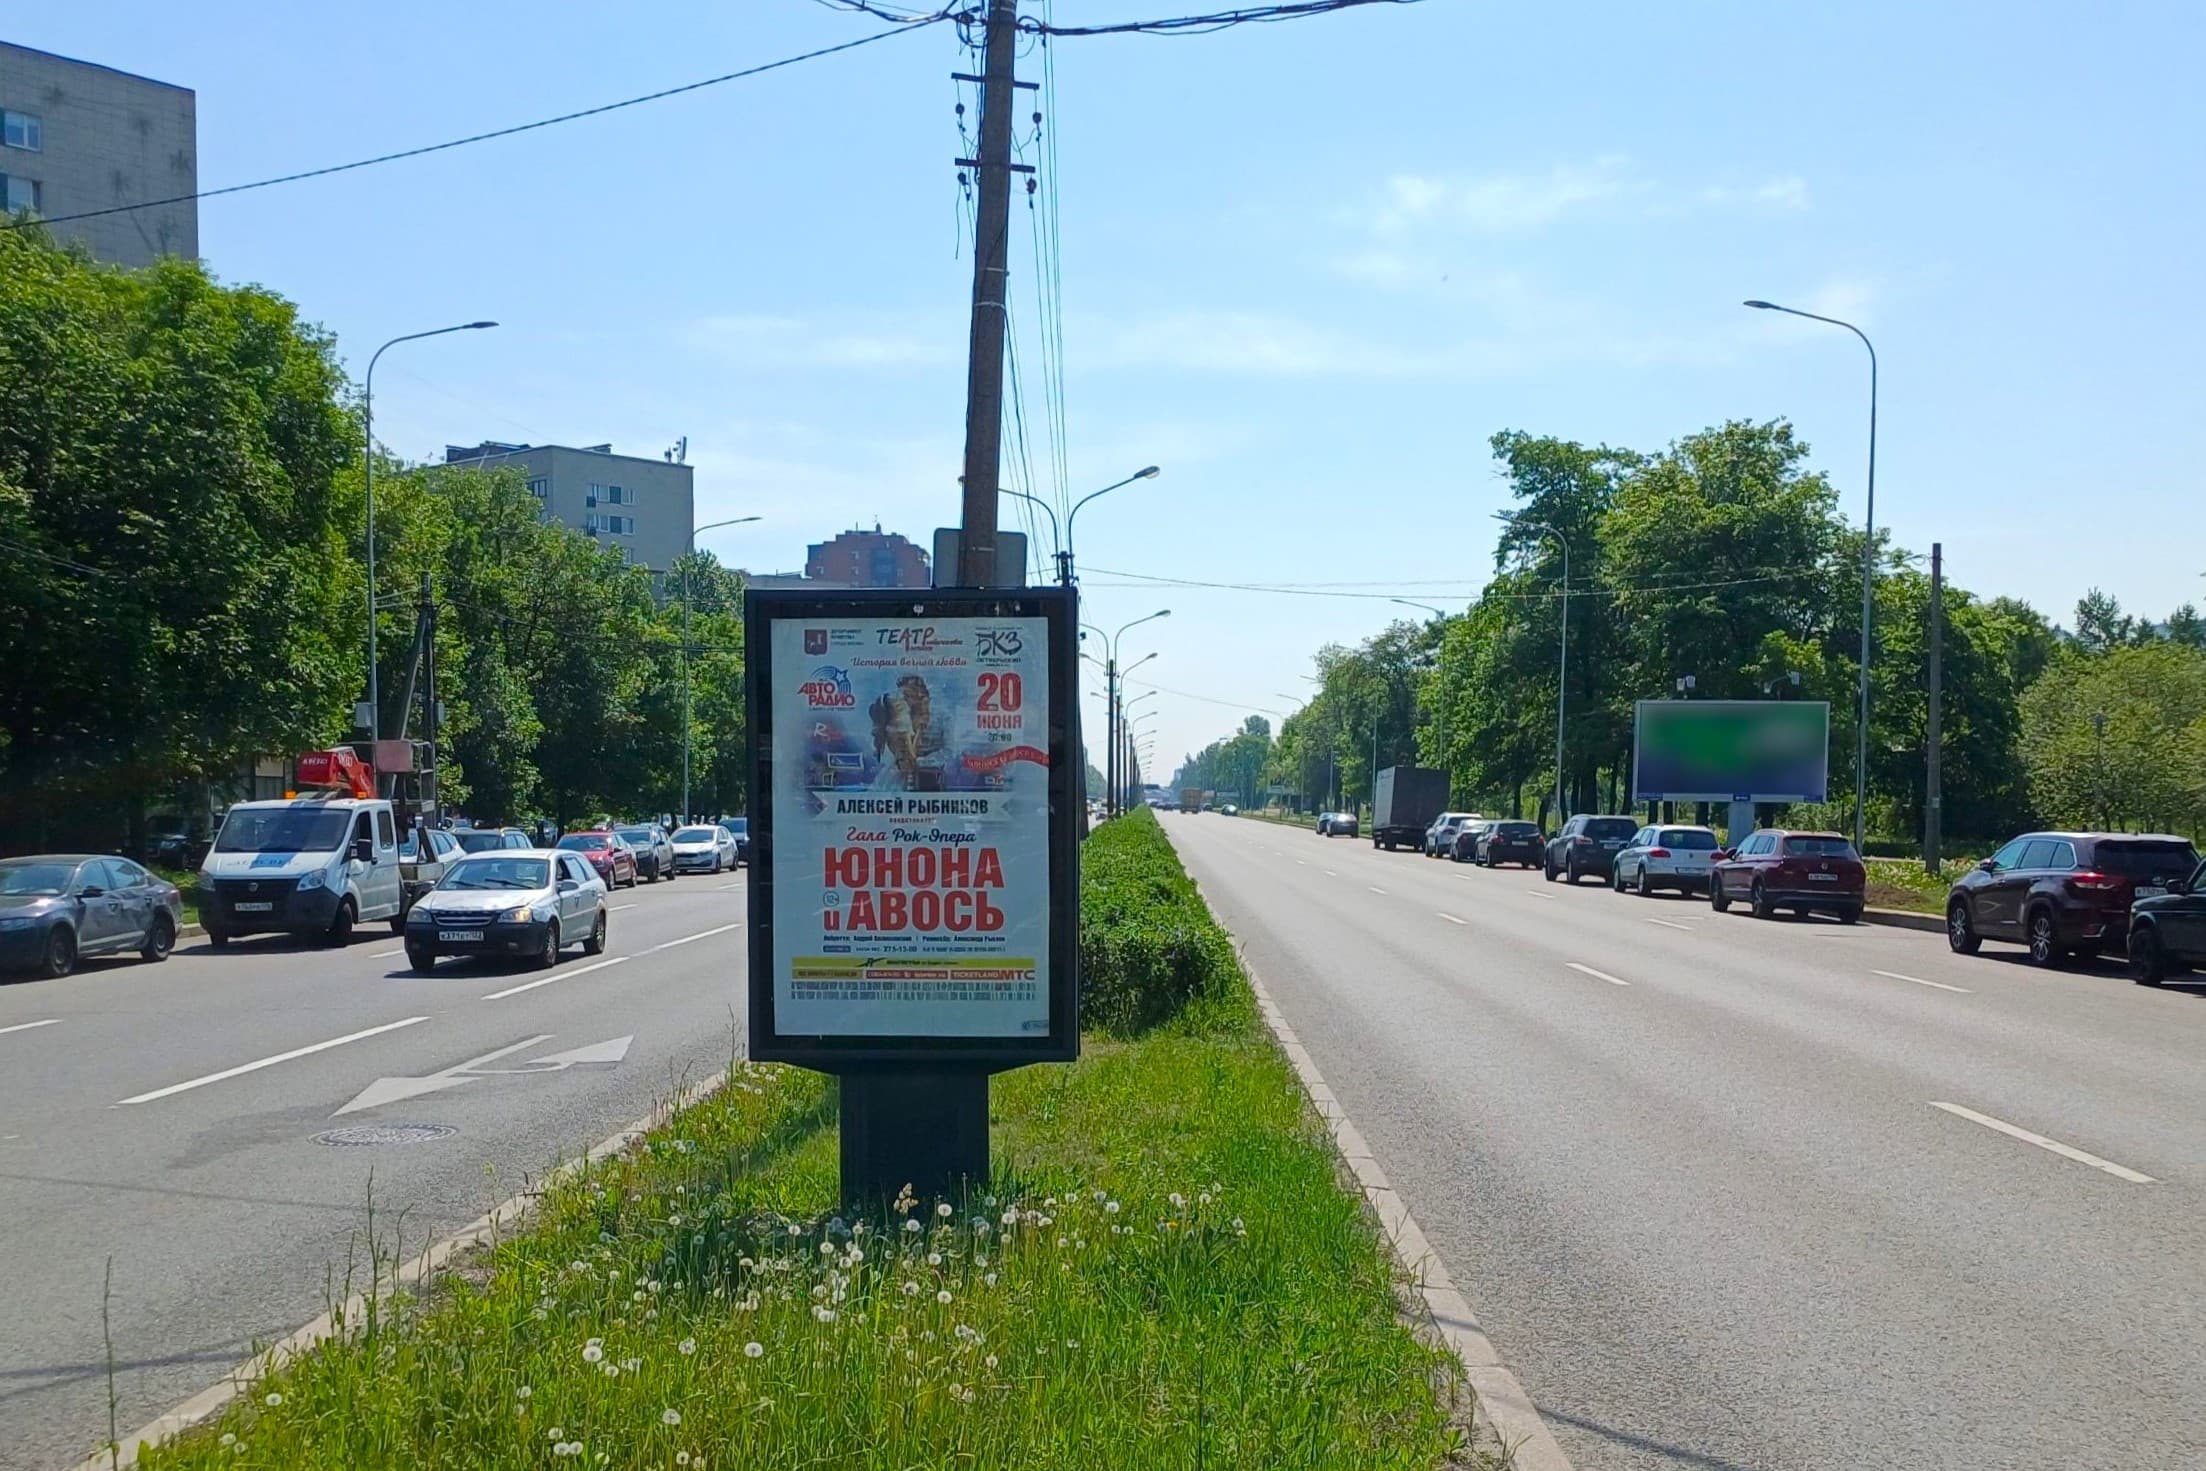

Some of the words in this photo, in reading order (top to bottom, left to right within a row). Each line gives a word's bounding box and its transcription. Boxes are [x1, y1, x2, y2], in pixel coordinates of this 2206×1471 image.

[876, 627, 935, 652] ТЕАТР
[975, 630, 1023, 657] БКЗ
[797, 682, 836, 695] АВТО
[808, 694, 856, 707] РАДИО
[976, 671, 1022, 712] 20
[836, 796, 904, 815] АЛЕКСЕЙ
[907, 799, 989, 815] РЫБНИКОВ
[823, 846, 1006, 889] ЮНОНА
[823, 910, 841, 932] и
[845, 890, 1006, 932] АВОСЬ
[1000, 969, 1036, 980] МТС
